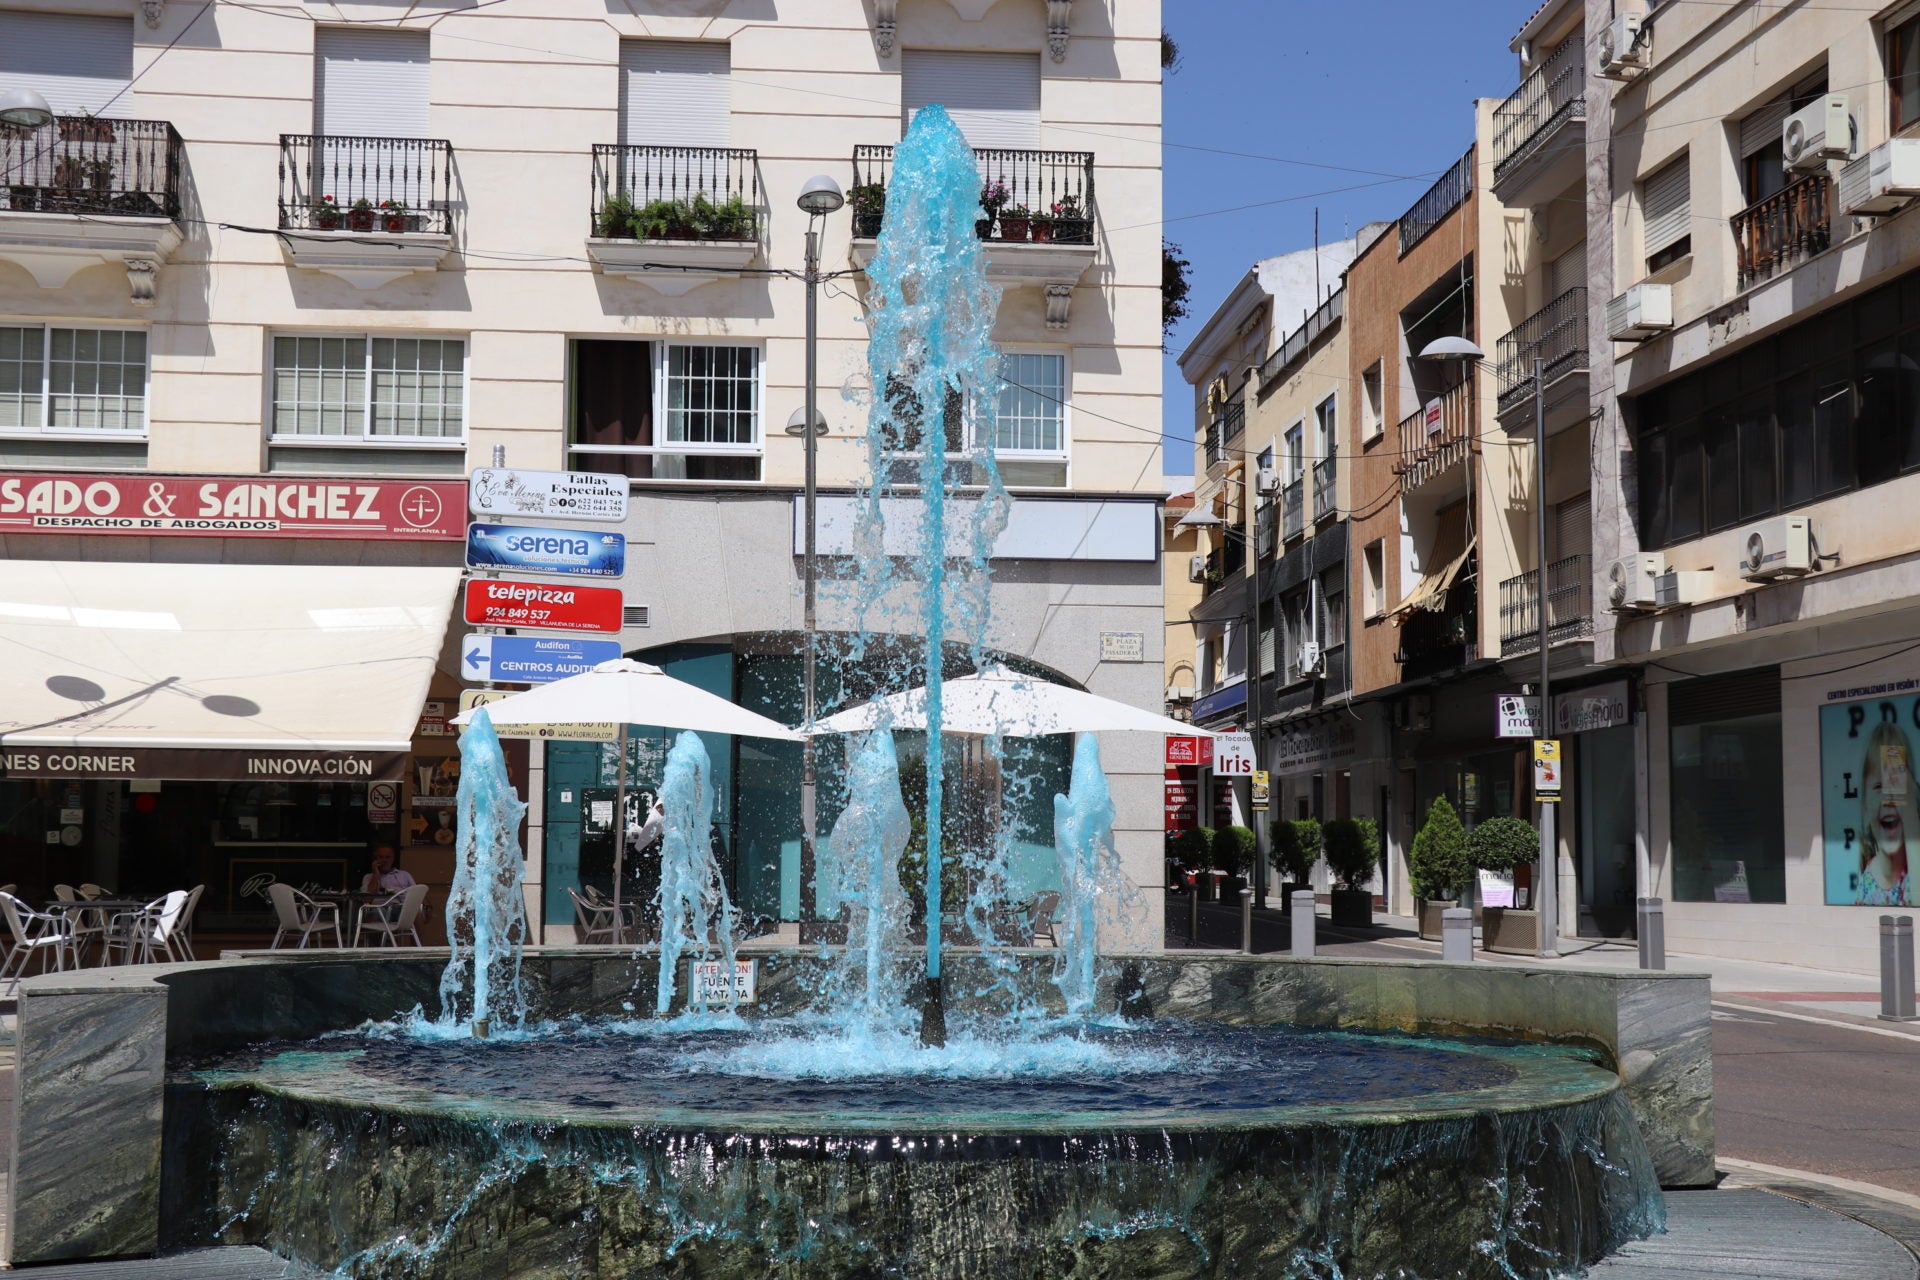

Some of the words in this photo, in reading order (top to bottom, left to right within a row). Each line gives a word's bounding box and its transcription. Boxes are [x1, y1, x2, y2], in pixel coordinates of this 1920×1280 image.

[567, 474, 608, 485] Tallas
[489, 482, 508, 496] Eva
[552, 484, 623, 497] Especiales
[143, 482, 177, 517] &
[198, 483, 380, 520] SANCHEZ
[37, 517, 133, 527] DESPACHO
[140, 519, 162, 528] DE
[171, 519, 277, 530] ABOGADOS
[505, 535, 589, 556] serena
[523, 556, 559, 564] soluciones
[475, 562, 558, 572] www.serenasoluciones.com
[487, 583, 575, 607] telepizza
[485, 607, 506, 617] 924
[508, 609, 528, 619] 849
[530, 610, 551, 620] 537
[535, 640, 570, 651] Audifon
[500, 661, 553, 673] CENTROS
[556, 663, 596, 674] AUDITI
[1518, 704, 1543, 718] viaje
[1508, 716, 1541, 727] mari
[47, 754, 136, 772] CORNER
[248, 755, 373, 776] INNOVACIÓN
[1220, 754, 1251, 773] Iris
[1843, 773, 1857, 798] L
[1843, 828, 1856, 849] P
[695, 964, 751, 975] ¡ATEÓN!
